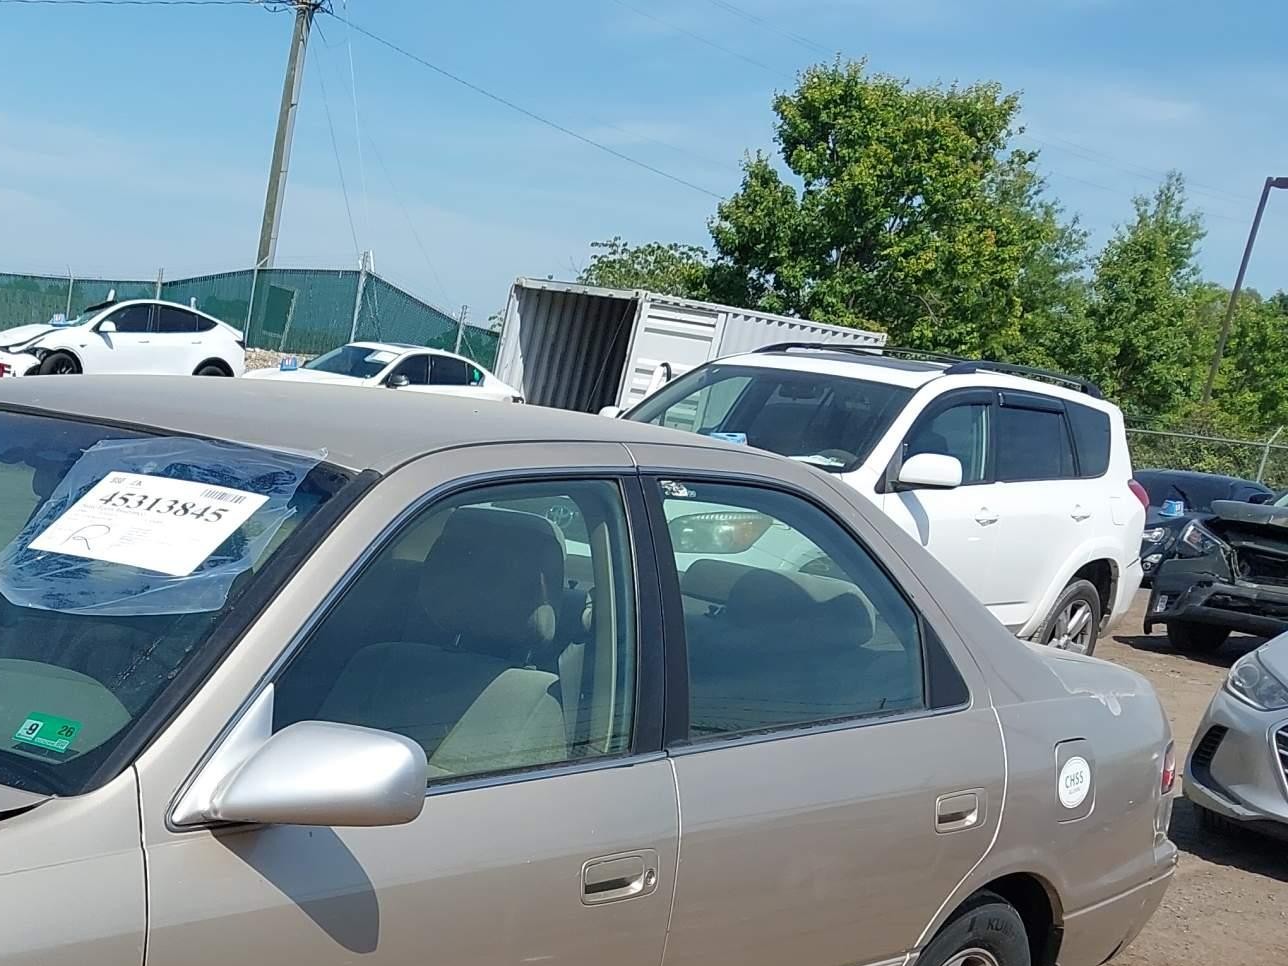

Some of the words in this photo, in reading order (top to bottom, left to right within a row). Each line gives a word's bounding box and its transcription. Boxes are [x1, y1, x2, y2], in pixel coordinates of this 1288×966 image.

[98, 490, 231, 523] 45313845
[26, 723, 40, 736] 9
[57, 725, 76, 738] 26
[1064, 770, 1084, 789] CHSS
